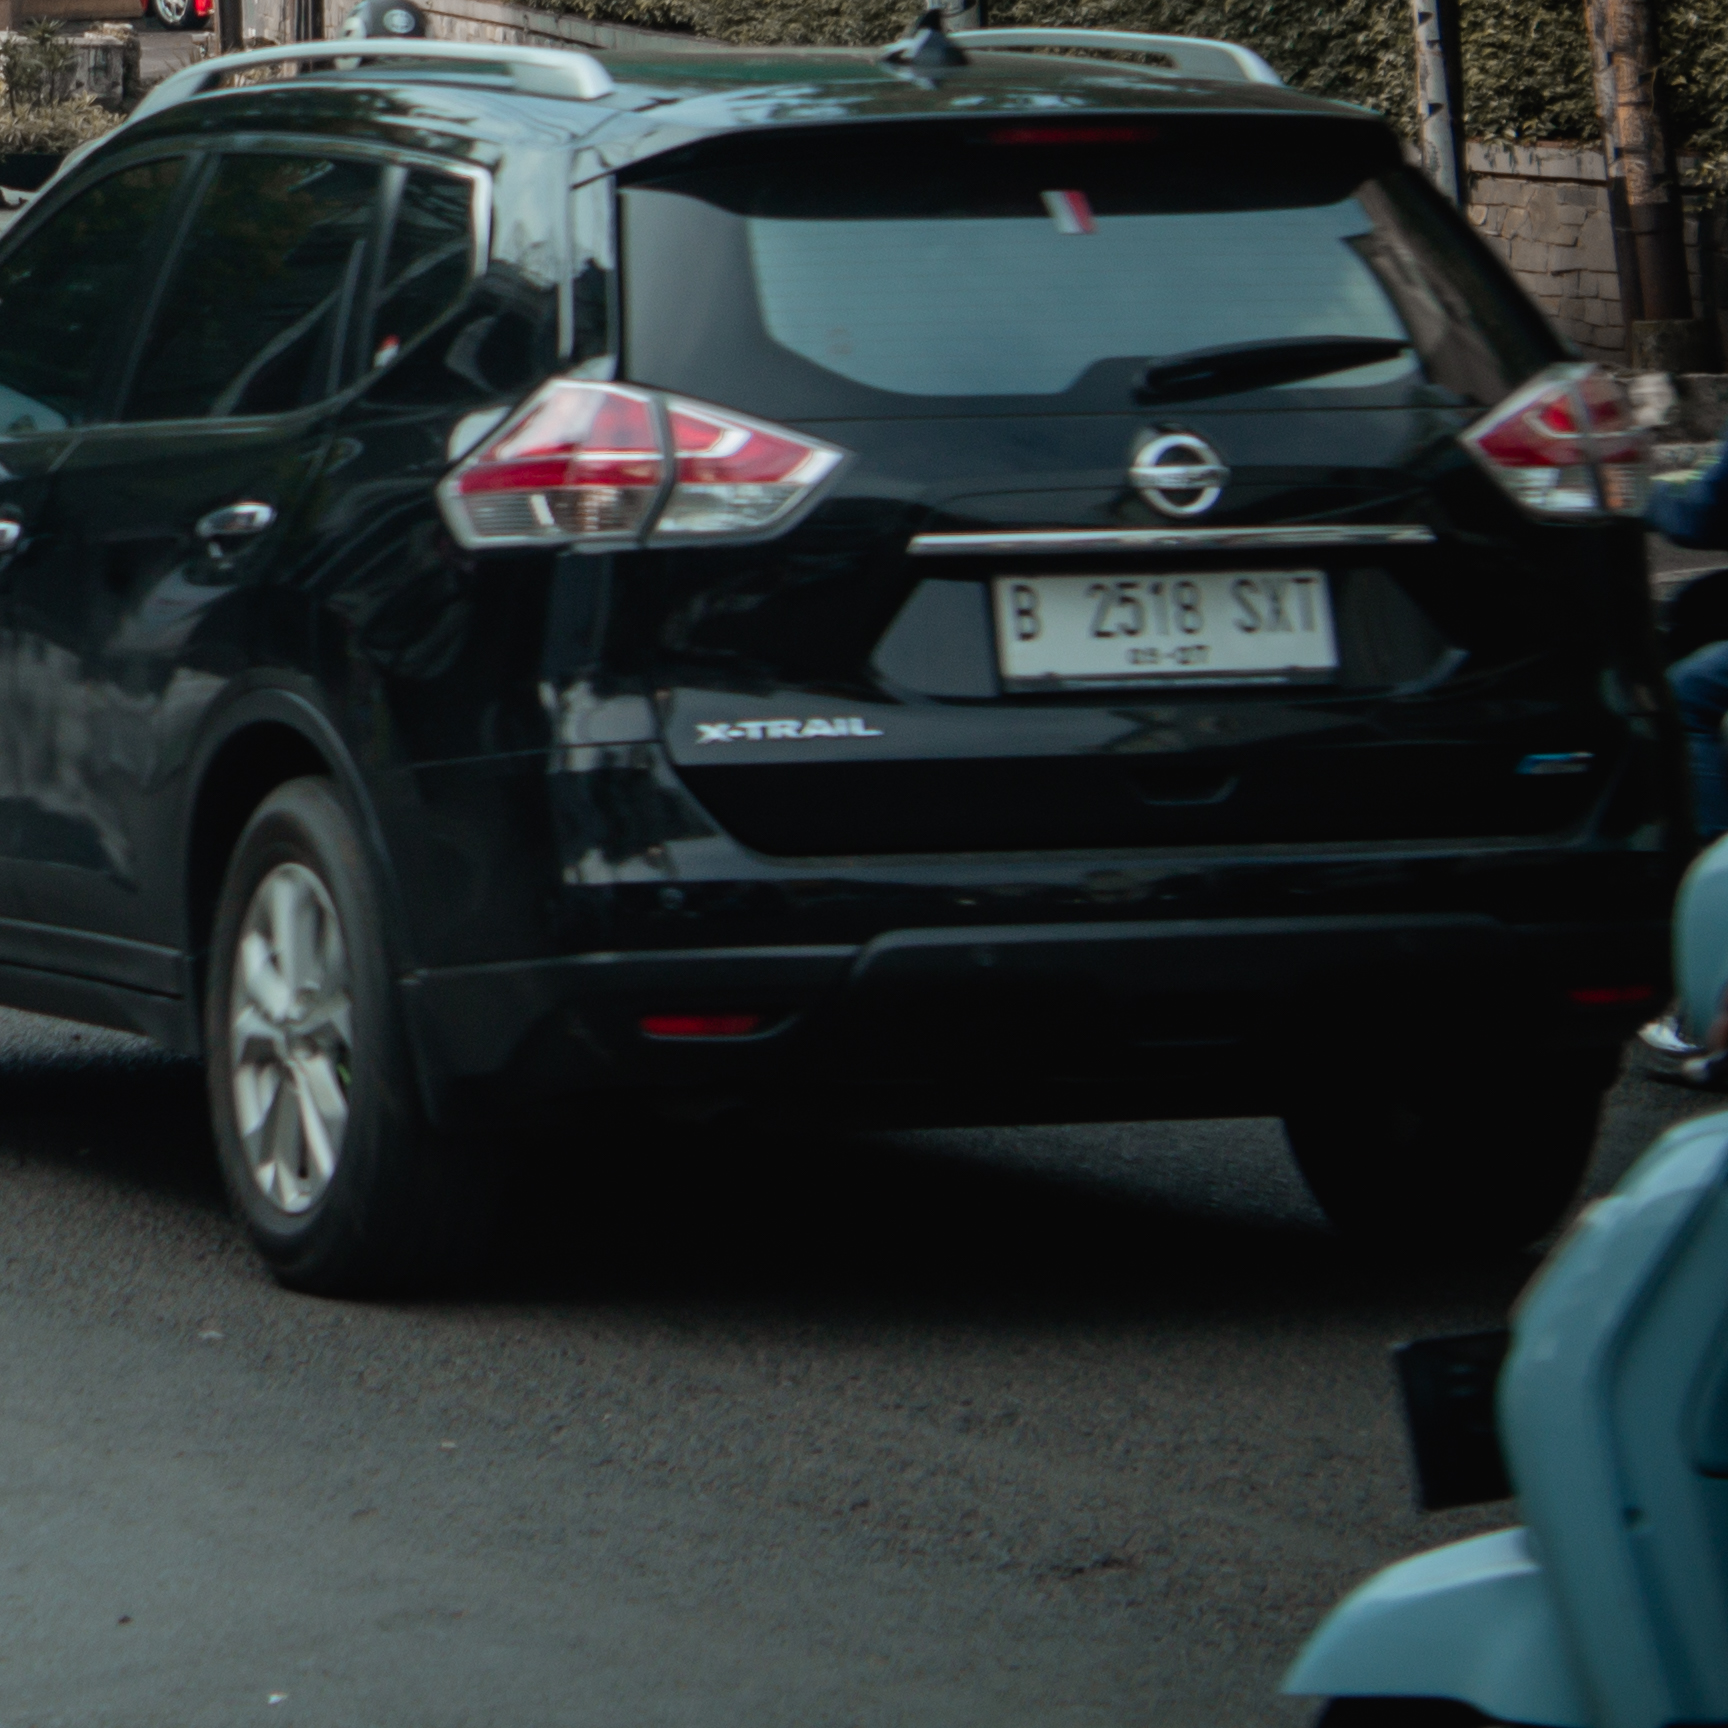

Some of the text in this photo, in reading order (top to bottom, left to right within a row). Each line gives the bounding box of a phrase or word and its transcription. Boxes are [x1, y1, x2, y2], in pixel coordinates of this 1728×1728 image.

[1012, 577, 1318, 641] B 2518 SXT
[695, 717, 885, 745] X-TRAIL
